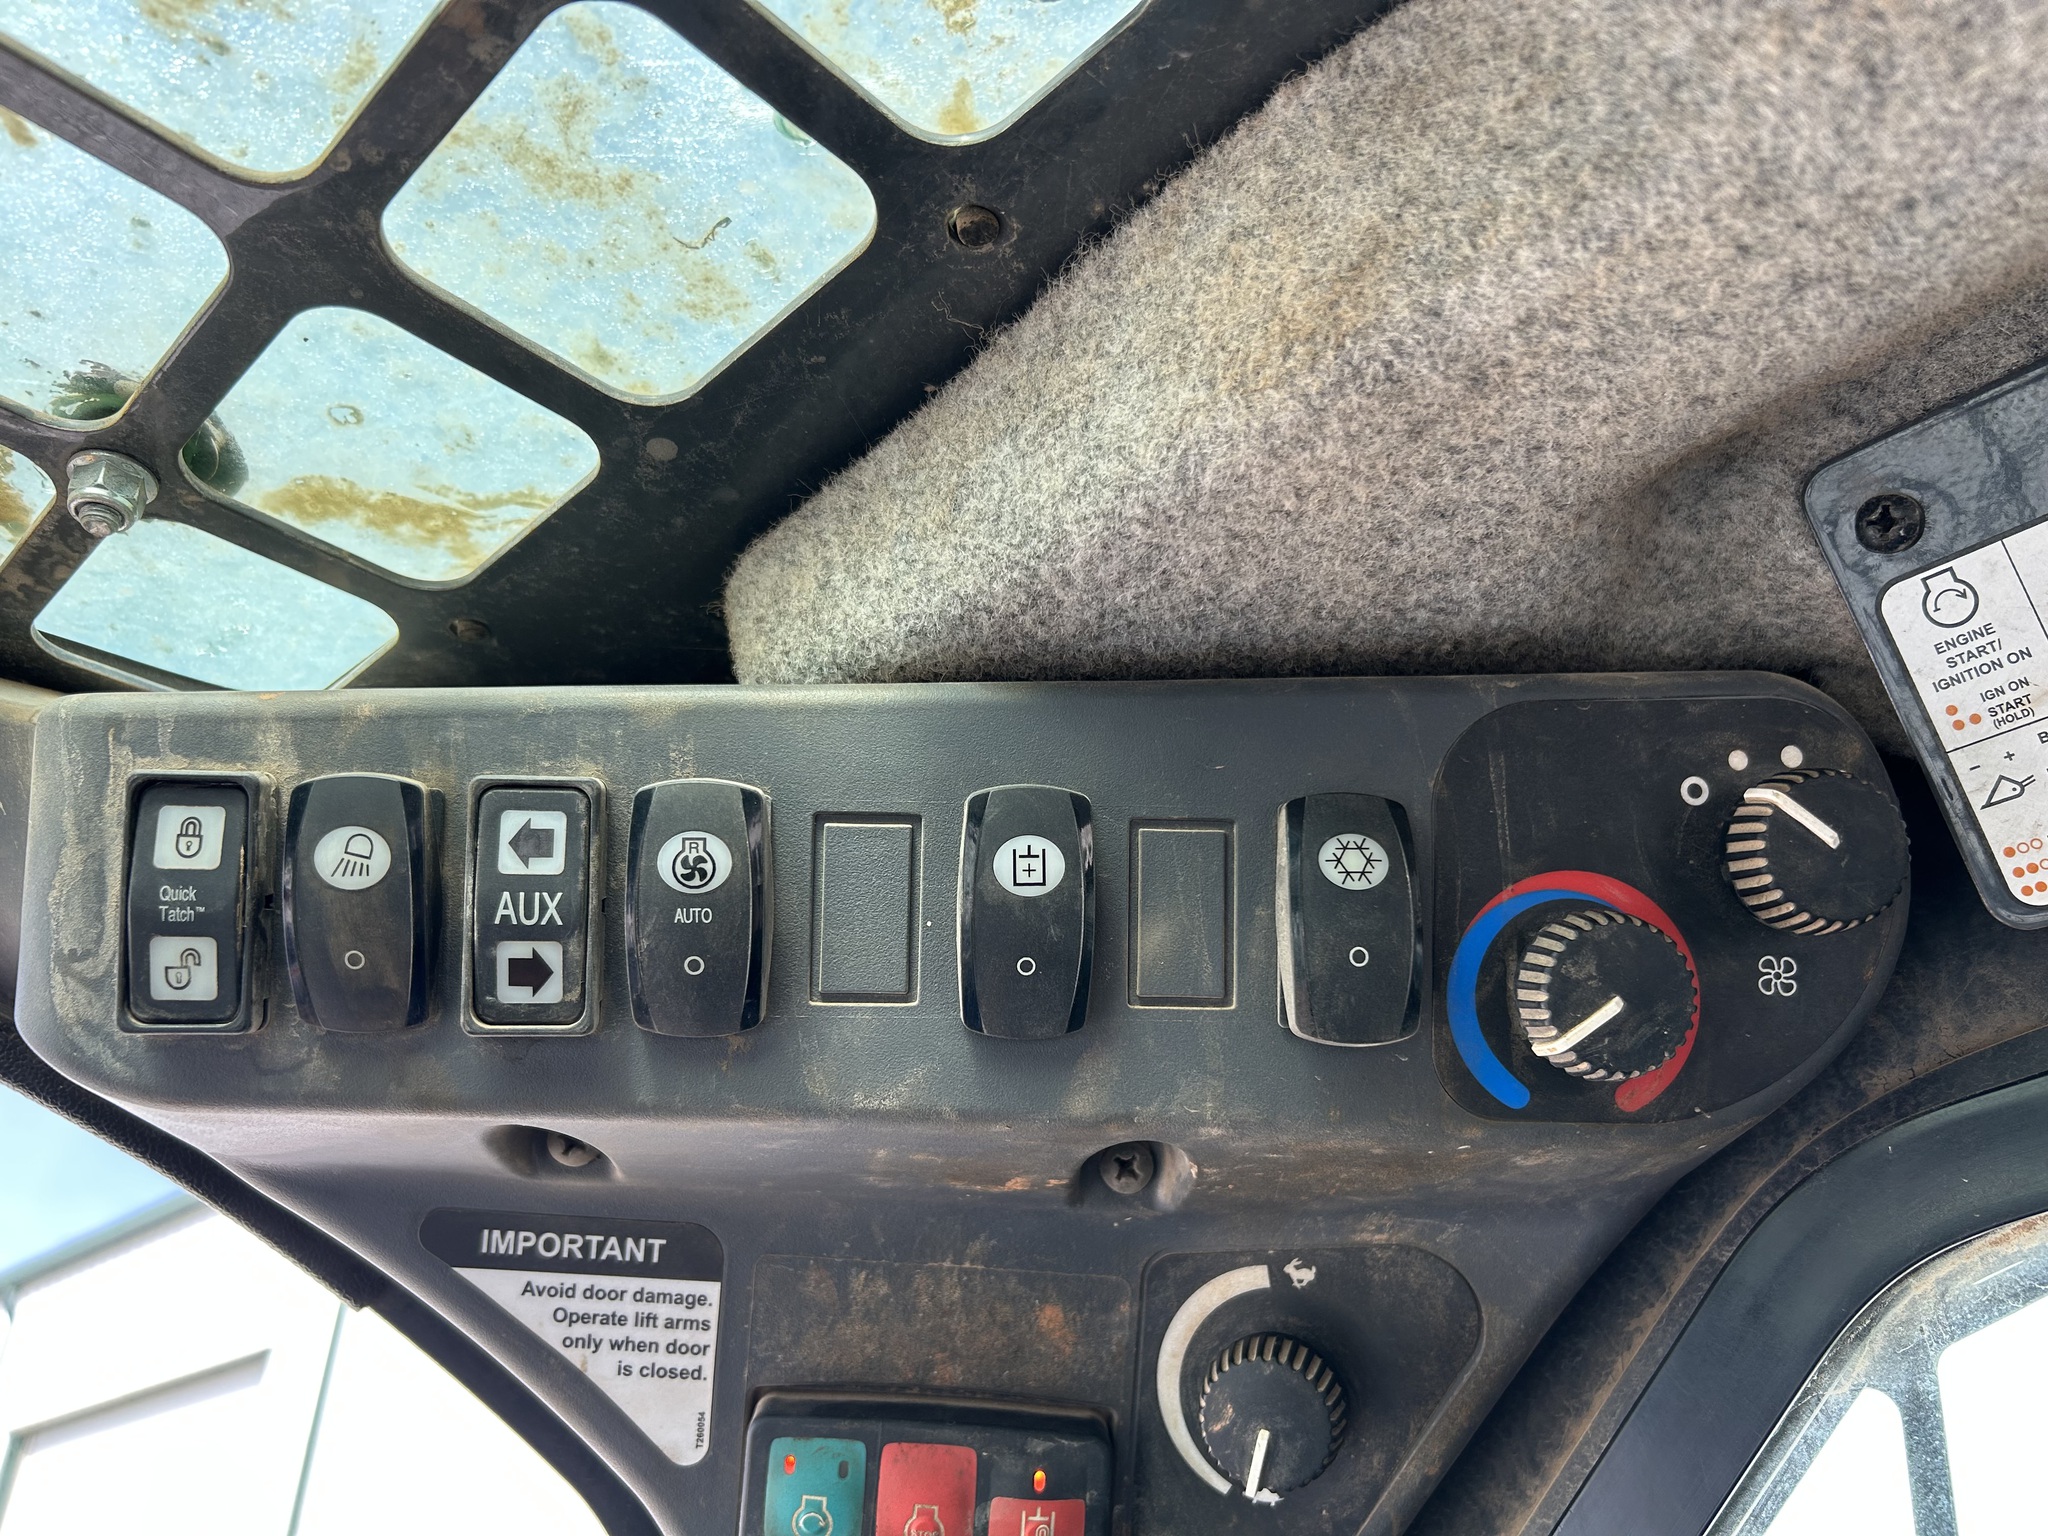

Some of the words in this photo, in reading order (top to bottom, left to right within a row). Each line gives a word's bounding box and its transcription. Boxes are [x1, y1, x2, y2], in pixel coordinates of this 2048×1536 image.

[1933, 622, 1996, 655] ENGINE
[1945, 638, 2002, 669] START/
[1932, 657, 2004, 693] IGNITION
[2006, 646, 2033, 665] ON
[1980, 685, 2006, 703] IGN
[2007, 676, 2030, 692] ON
[1987, 693, 2032, 718] START
[1993, 706, 2035, 730] (HOLD)
[159, 885, 197, 901] Quick
[494, 891, 564, 926] AUX
[674, 907, 713, 924] AUTO
[481, 1228, 667, 1264] IMPORTANT
[520, 1280, 577, 1299] Avoid
[582, 1283, 628, 1302] door
[632, 1286, 713, 1310] damage.
[552, 1306, 628, 1328] Operate
[634, 1311, 659, 1329] lift
[664, 1316, 712, 1332] arms
[562, 1333, 604, 1354] only
[608, 1335, 660, 1354] when
[665, 1338, 711, 1357] door
[616, 1360, 634, 1377] is
[639, 1361, 708, 1381] closed.
